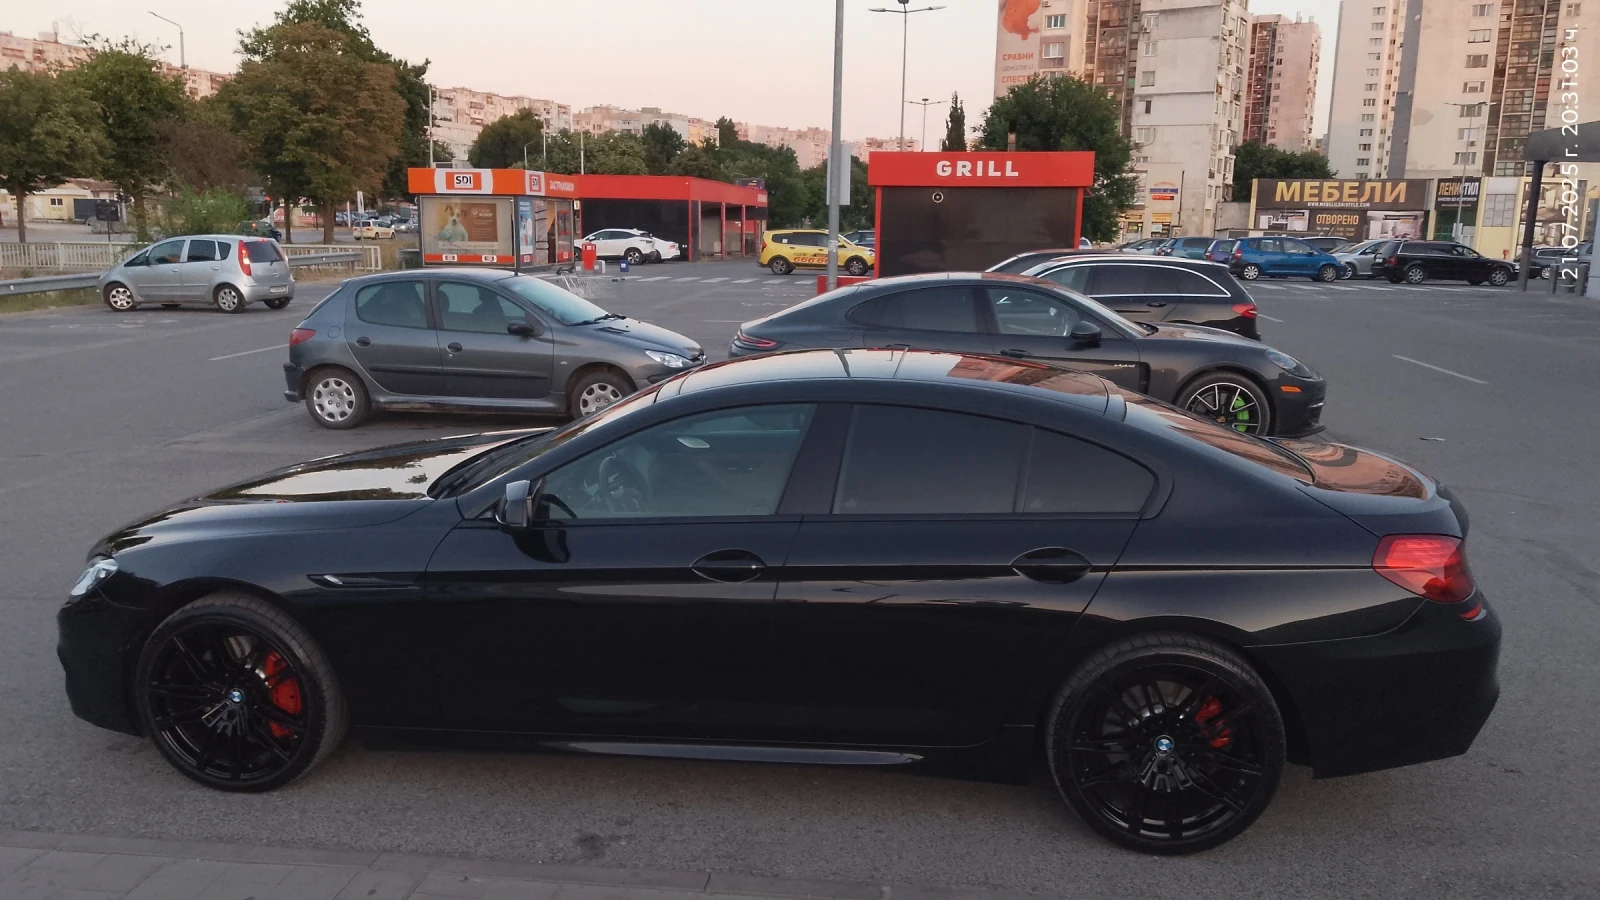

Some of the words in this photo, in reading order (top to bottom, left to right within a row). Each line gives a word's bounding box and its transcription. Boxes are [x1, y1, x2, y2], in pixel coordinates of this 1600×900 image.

[1002, 52, 1034, 61] СРАВНИ
[936, 160, 1019, 177] GRILL
[455, 175, 472, 185] SDI
[1275, 181, 1407, 203] МЕБЕЛИ
[1316, 214, 1359, 225] ОТВОРЕНО
